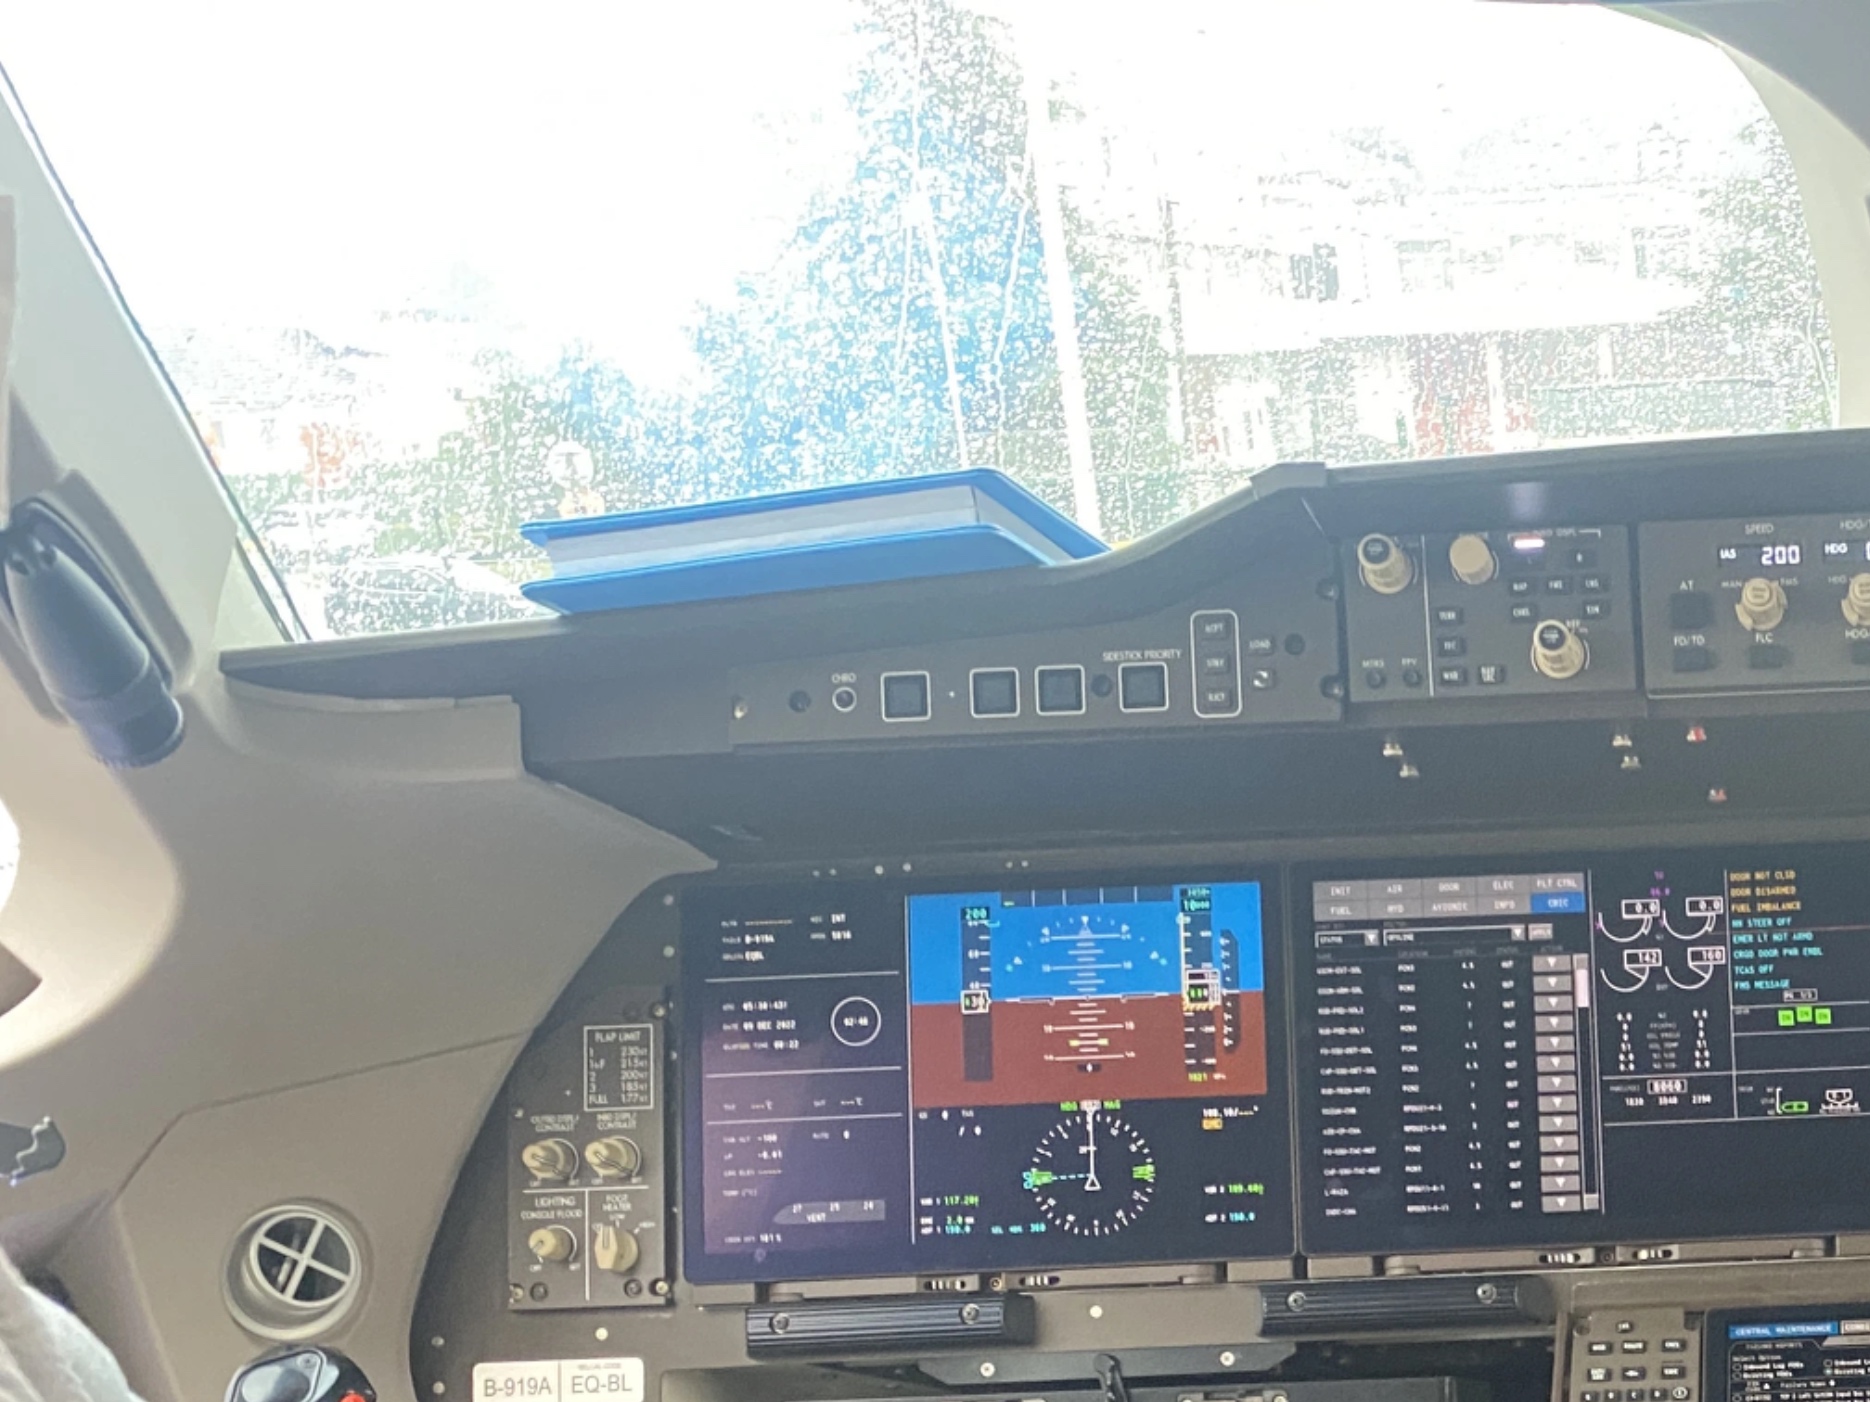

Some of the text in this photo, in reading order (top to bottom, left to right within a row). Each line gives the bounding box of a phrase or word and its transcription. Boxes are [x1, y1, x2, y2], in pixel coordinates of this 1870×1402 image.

[1745, 523, 1774, 534] SPEED
[1824, 543, 1848, 554] HDG
[1720, 545, 1800, 565] IAS 200
[1680, 581, 1693, 590] AT
[1674, 635, 1705, 646] FD/TD
[1756, 632, 1773, 643] FLC
[1103, 649, 1182, 661] SIDESTICK PRIORITY
[1730, 871, 1796, 881] DOOR NOT CLSD
[1387, 884, 1402, 893] AIR
[1493, 881, 1514, 890] ELEC
[1331, 886, 1351, 896] INIT
[1730, 886, 1796, 897] DOOR DISARMED
[1331, 906, 1351, 915] FUEL
[1432, 903, 1468, 912] AVIONIC
[1494, 901, 1515, 910] INFO
[1635, 903, 1658, 913] 0.0
[1699, 901, 1720, 911] 0.0
[1731, 901, 1801, 912] FUEL IMBALANCE
[965, 909, 987, 919] 200
[1748, 918, 1772, 927] STEER
[1776, 917, 1792, 926] OFF
[1758, 933, 1768, 942] LT
[1773, 932, 1788, 941] NOT
[1638, 952, 1657, 963] 142
[1702, 950, 1722, 960] 160
[1735, 964, 1774, 974] TCAS OFF
[1754, 979, 1790, 989] MESSAGE
[595, 1031, 641, 1042] FLAP LIMIT
[590, 1095, 608, 1104] FULL
[535, 1196, 575, 1207] LIGHTING
[557, 1209, 582, 1218] FLOOD
[1736, 1324, 1832, 1336] CENTRAL MAINTENANCE
[484, 1377, 552, 1397] B-919A
[572, 1374, 632, 1393] EQ-BL
